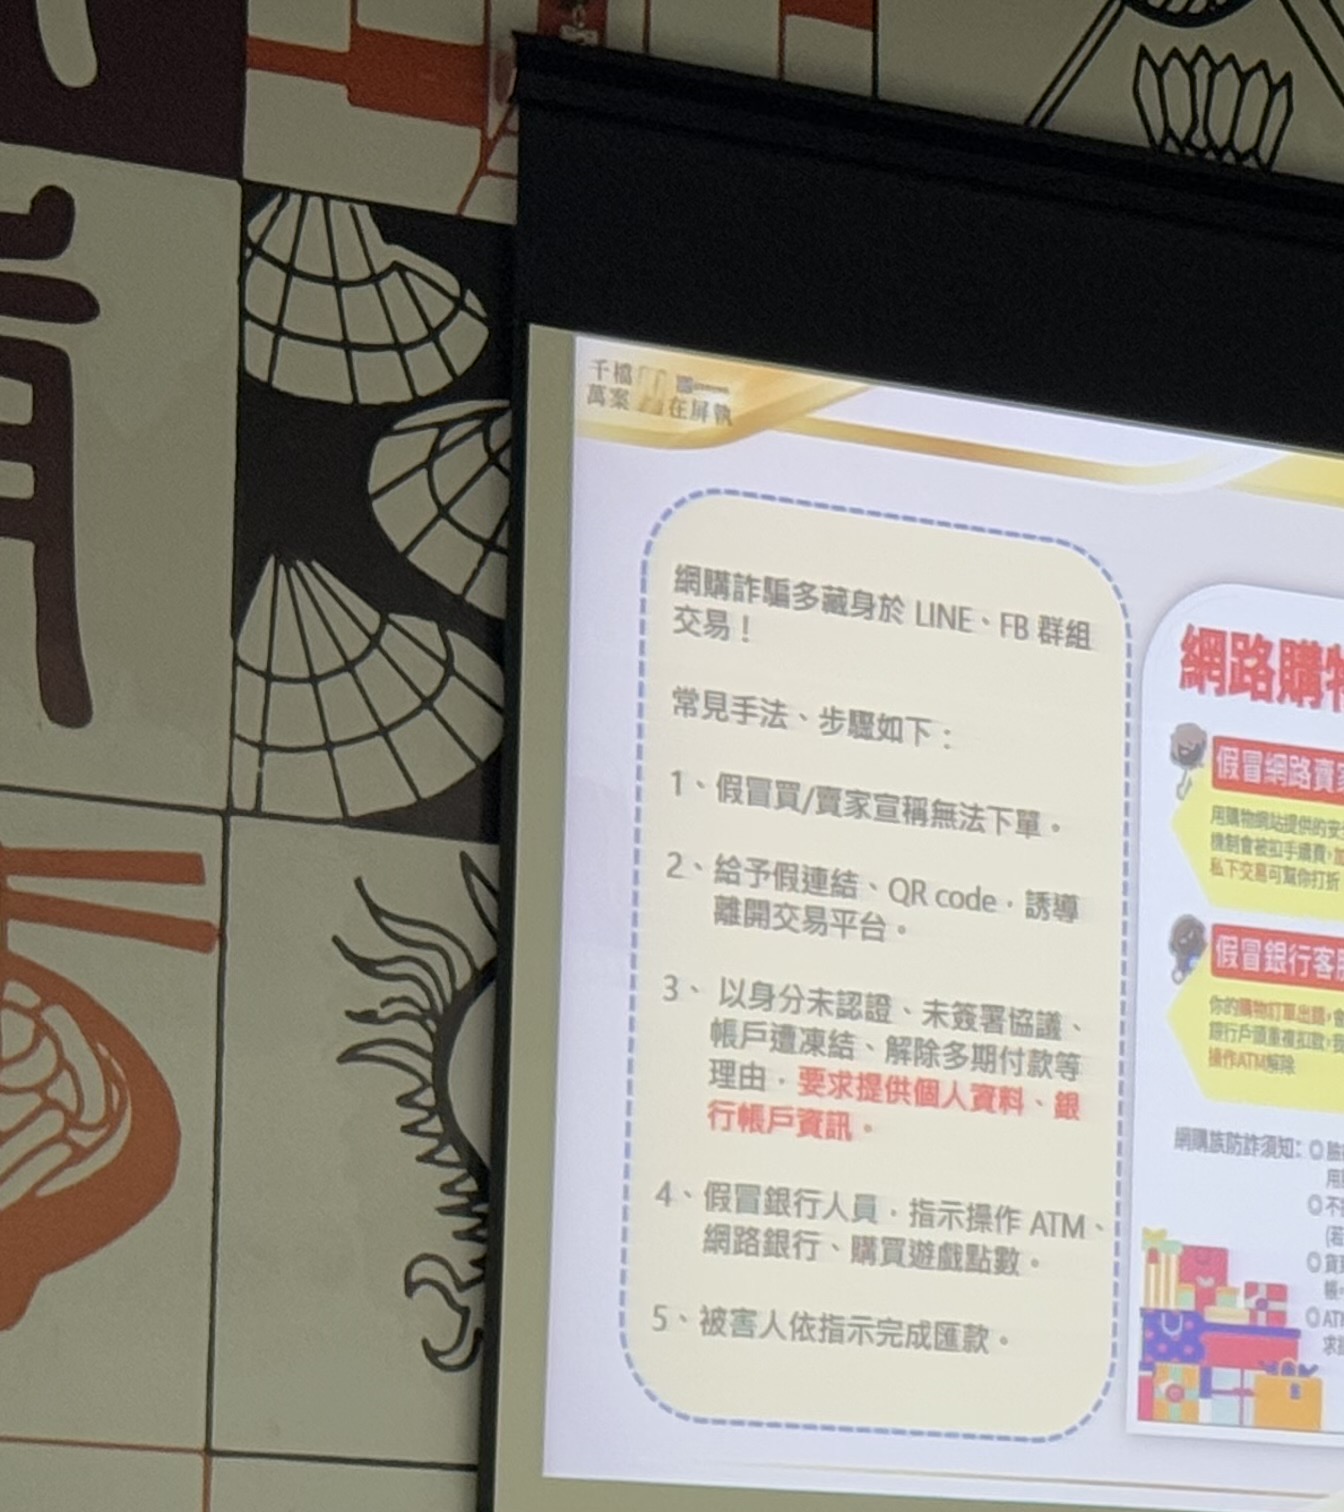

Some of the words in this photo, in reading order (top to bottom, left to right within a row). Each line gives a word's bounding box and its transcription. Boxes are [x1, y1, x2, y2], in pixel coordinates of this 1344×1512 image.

[673, 606, 751, 642] 交易！
[674, 564, 904, 623] 網購詐騙多藏身於
[1038, 615, 1091, 651] 群組
[713, 896, 907, 942] 離開交易平台。
[710, 1017, 1081, 1082] 帳戶遭凍結、解除多期付款等
[707, 1099, 873, 1141] 行帳戶資訊。
[703, 1223, 1040, 1277] 網路銀行、購買遊戲點數。
